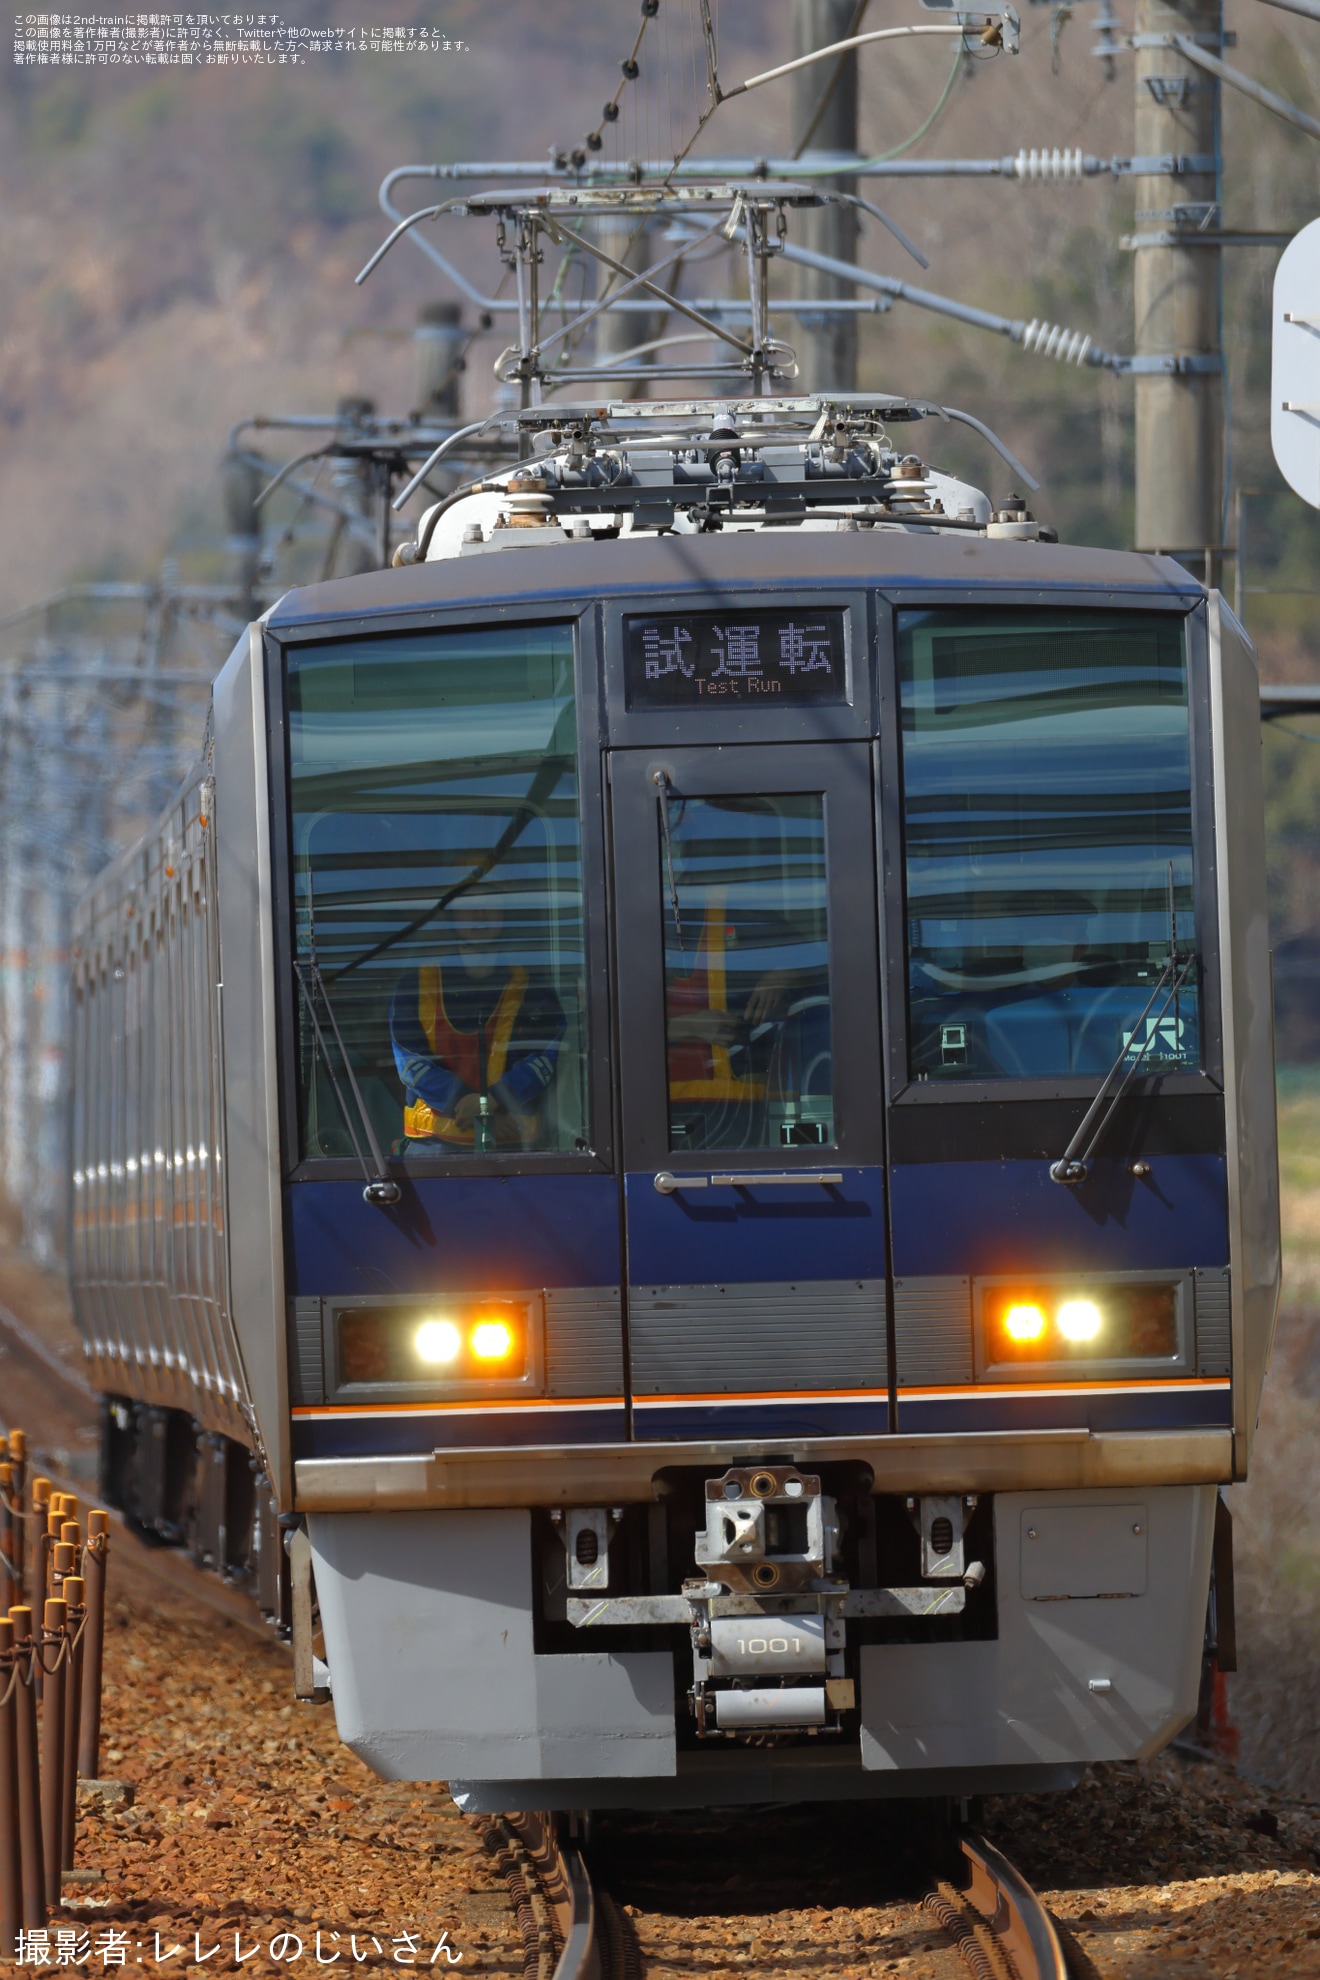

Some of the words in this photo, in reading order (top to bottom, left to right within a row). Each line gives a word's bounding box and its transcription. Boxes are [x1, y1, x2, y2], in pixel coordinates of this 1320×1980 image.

[642, 622, 832, 679] 試運転
[694, 678, 740, 694] Test
[747, 676, 782, 693] Run
[1122, 1017, 1186, 1052] JR
[737, 1638, 799, 1654] 1001
